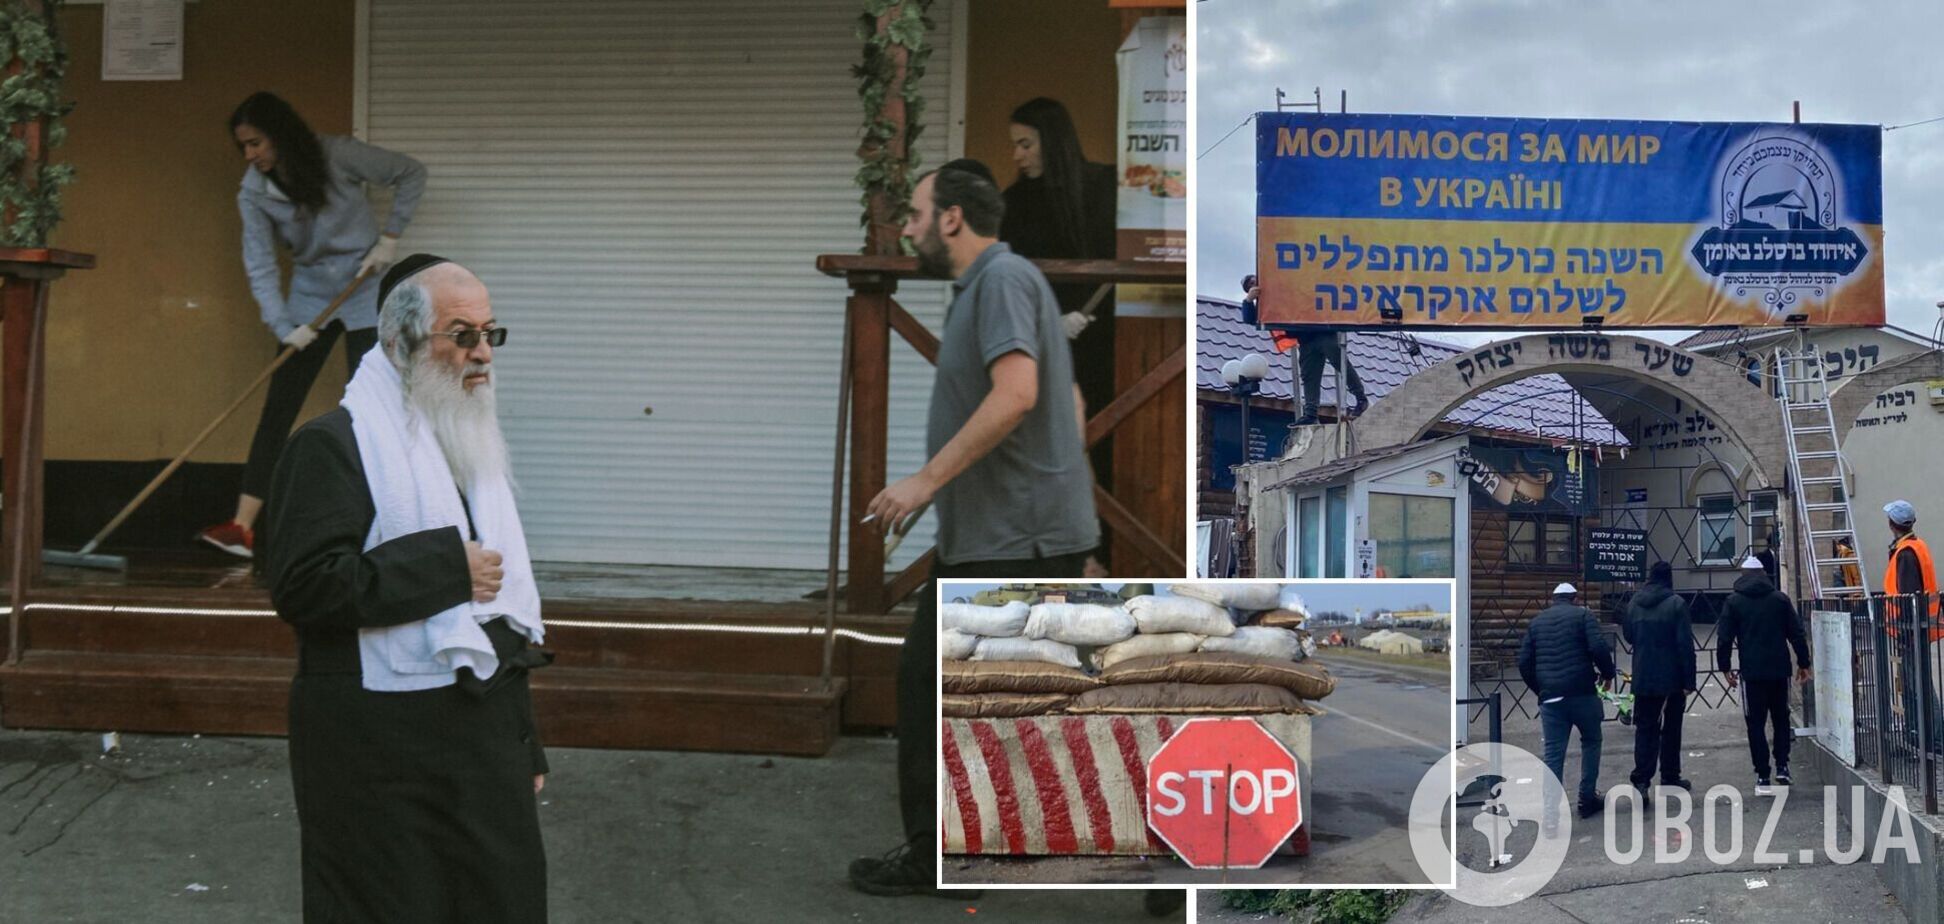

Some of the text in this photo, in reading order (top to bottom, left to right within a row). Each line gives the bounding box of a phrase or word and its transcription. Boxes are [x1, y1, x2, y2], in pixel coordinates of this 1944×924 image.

[1126, 134, 1179, 152] השבת
[1276, 127, 1661, 164] МОЛИМОСЯ ЗА МИР
[1379, 173, 1562, 210] В УКРАЇНІ
[1275, 234, 1664, 275] השנה כולנו מתפללים
[1703, 236, 1857, 267] איחוד ברסלב באומן
[1315, 278, 1627, 320] לשלום אוקראינה
[1455, 335, 1694, 387] שער משה יצחק
[1589, 541, 1645, 551] הכניסה לכהנים
[1599, 551, 1635, 561] אסורה
[1153, 768, 1296, 816] STOP
